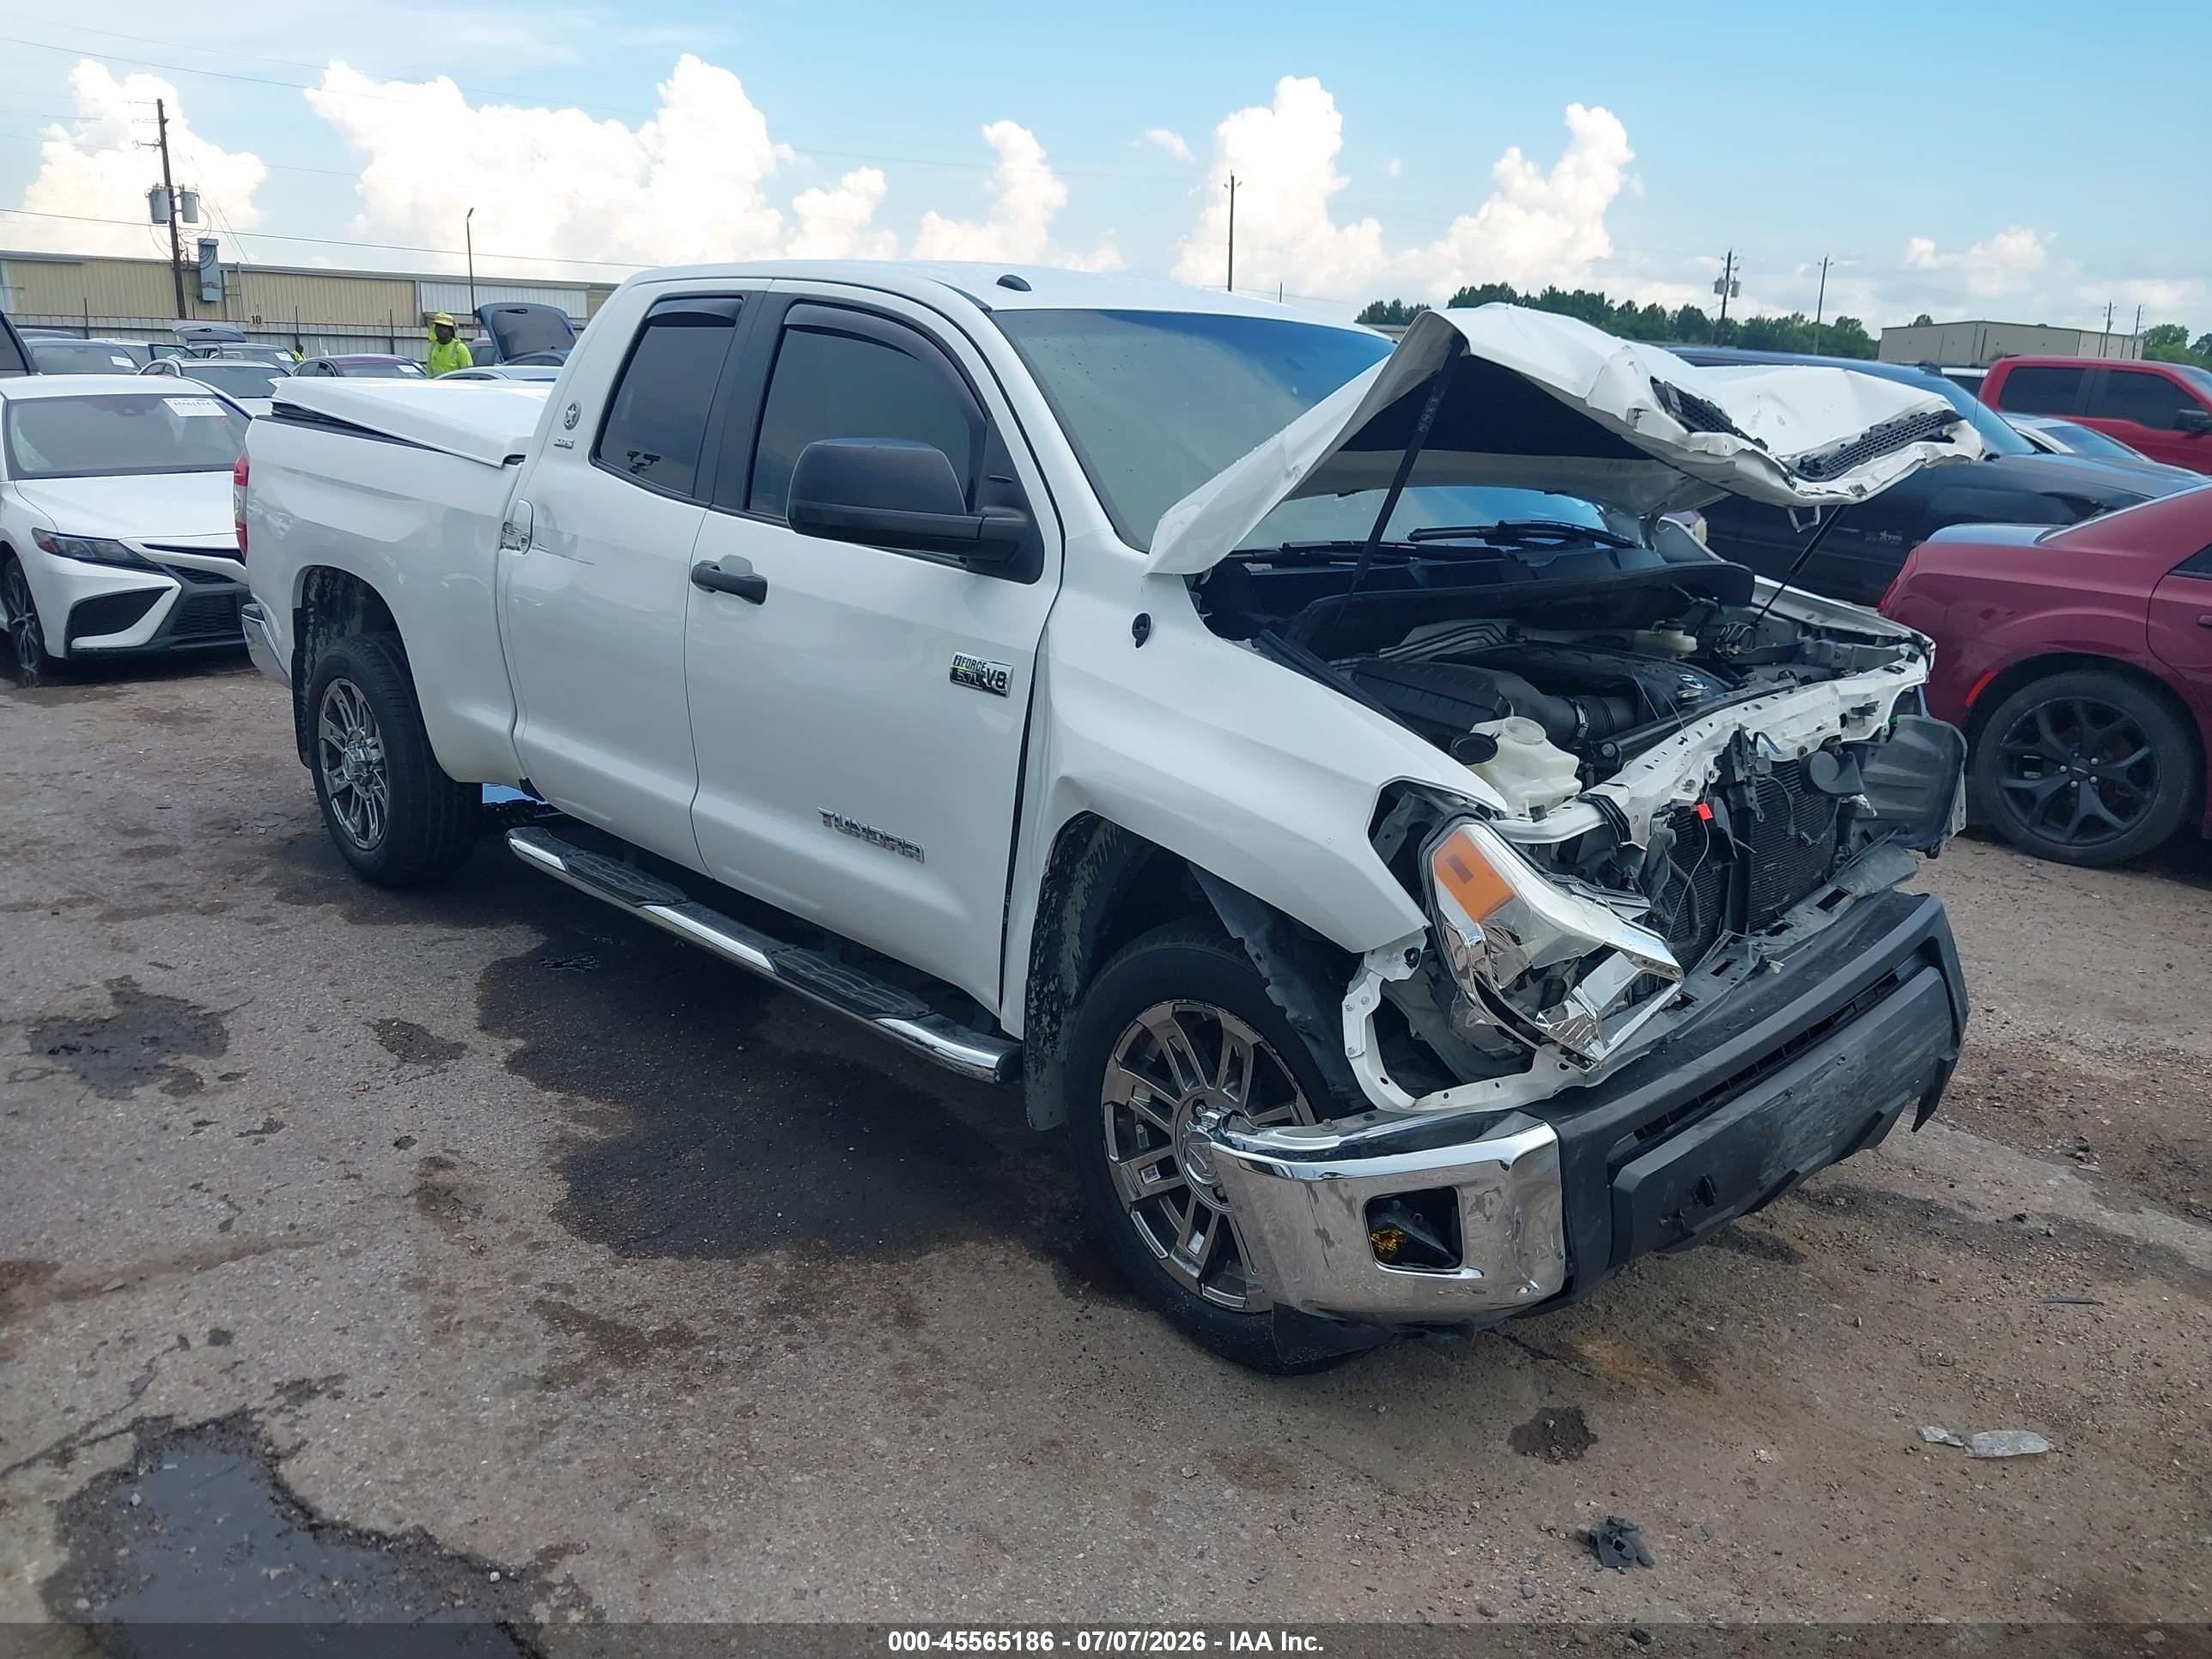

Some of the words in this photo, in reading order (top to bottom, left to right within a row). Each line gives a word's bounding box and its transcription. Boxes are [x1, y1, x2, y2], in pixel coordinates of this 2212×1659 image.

[250, 314, 262, 325] 10
[986, 667, 1007, 690] V8
[817, 806, 925, 864] TUNDRA
